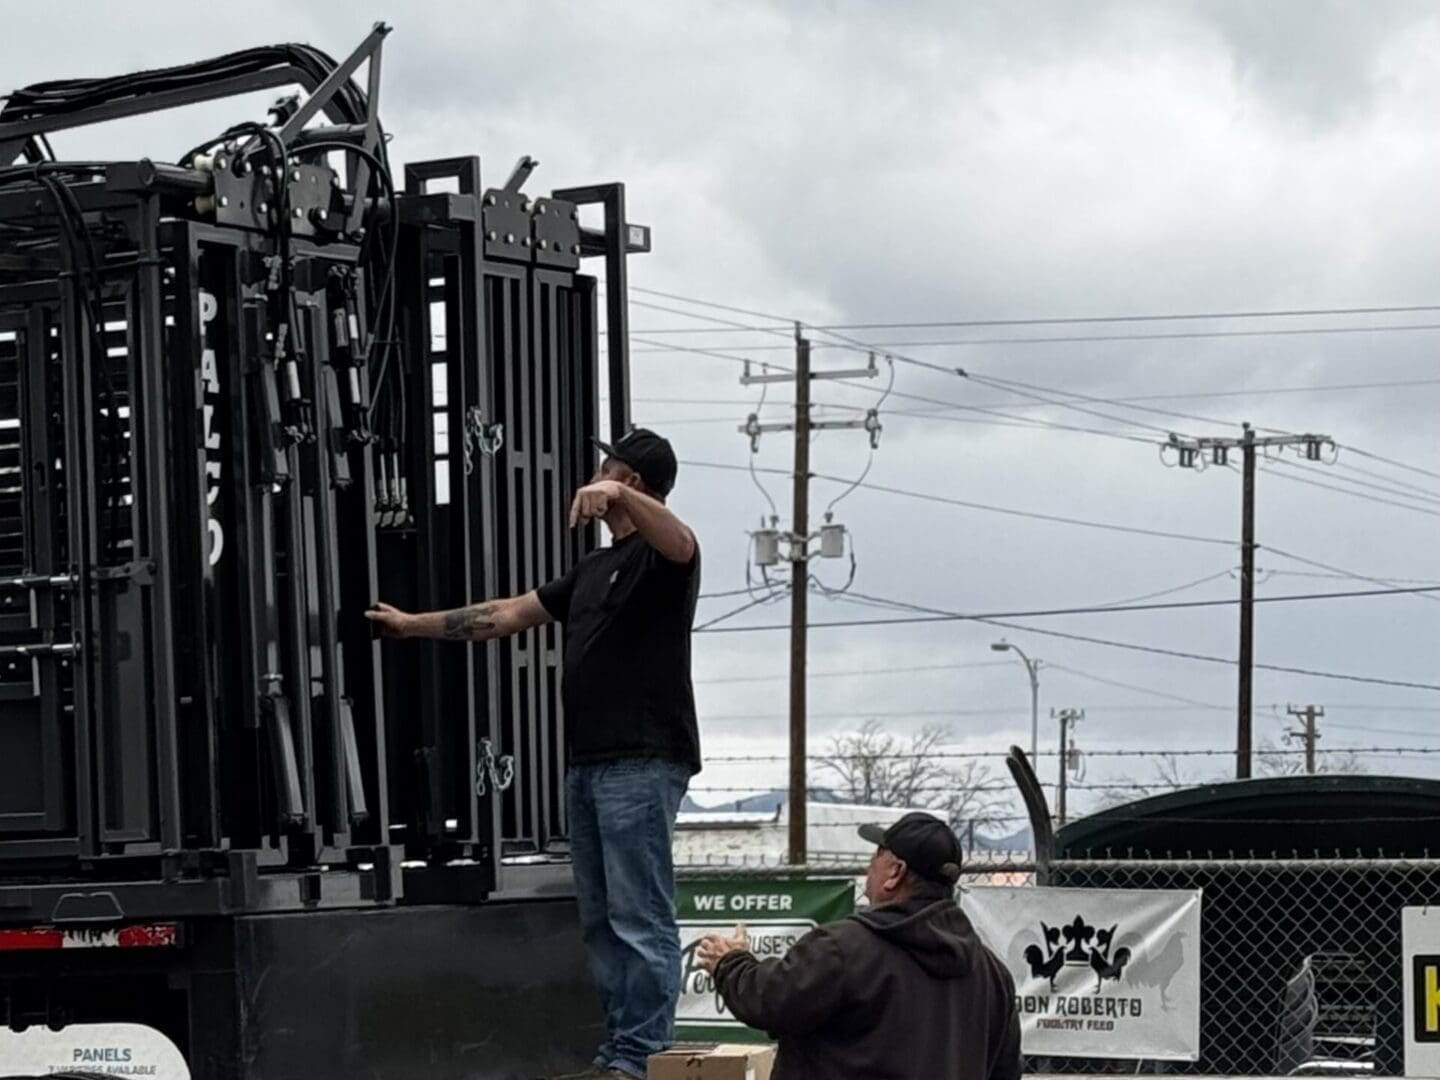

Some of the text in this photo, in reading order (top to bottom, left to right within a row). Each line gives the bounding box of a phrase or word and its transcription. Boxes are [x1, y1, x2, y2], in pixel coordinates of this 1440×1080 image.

[693, 895, 793, 910] WE OFFER
[1056, 996, 1142, 1018] ROBERTO
[1087, 1020, 1114, 1031] FEED
[73, 1048, 132, 1062] PANELS
[106, 1065, 157, 1075] AVAILABLE
